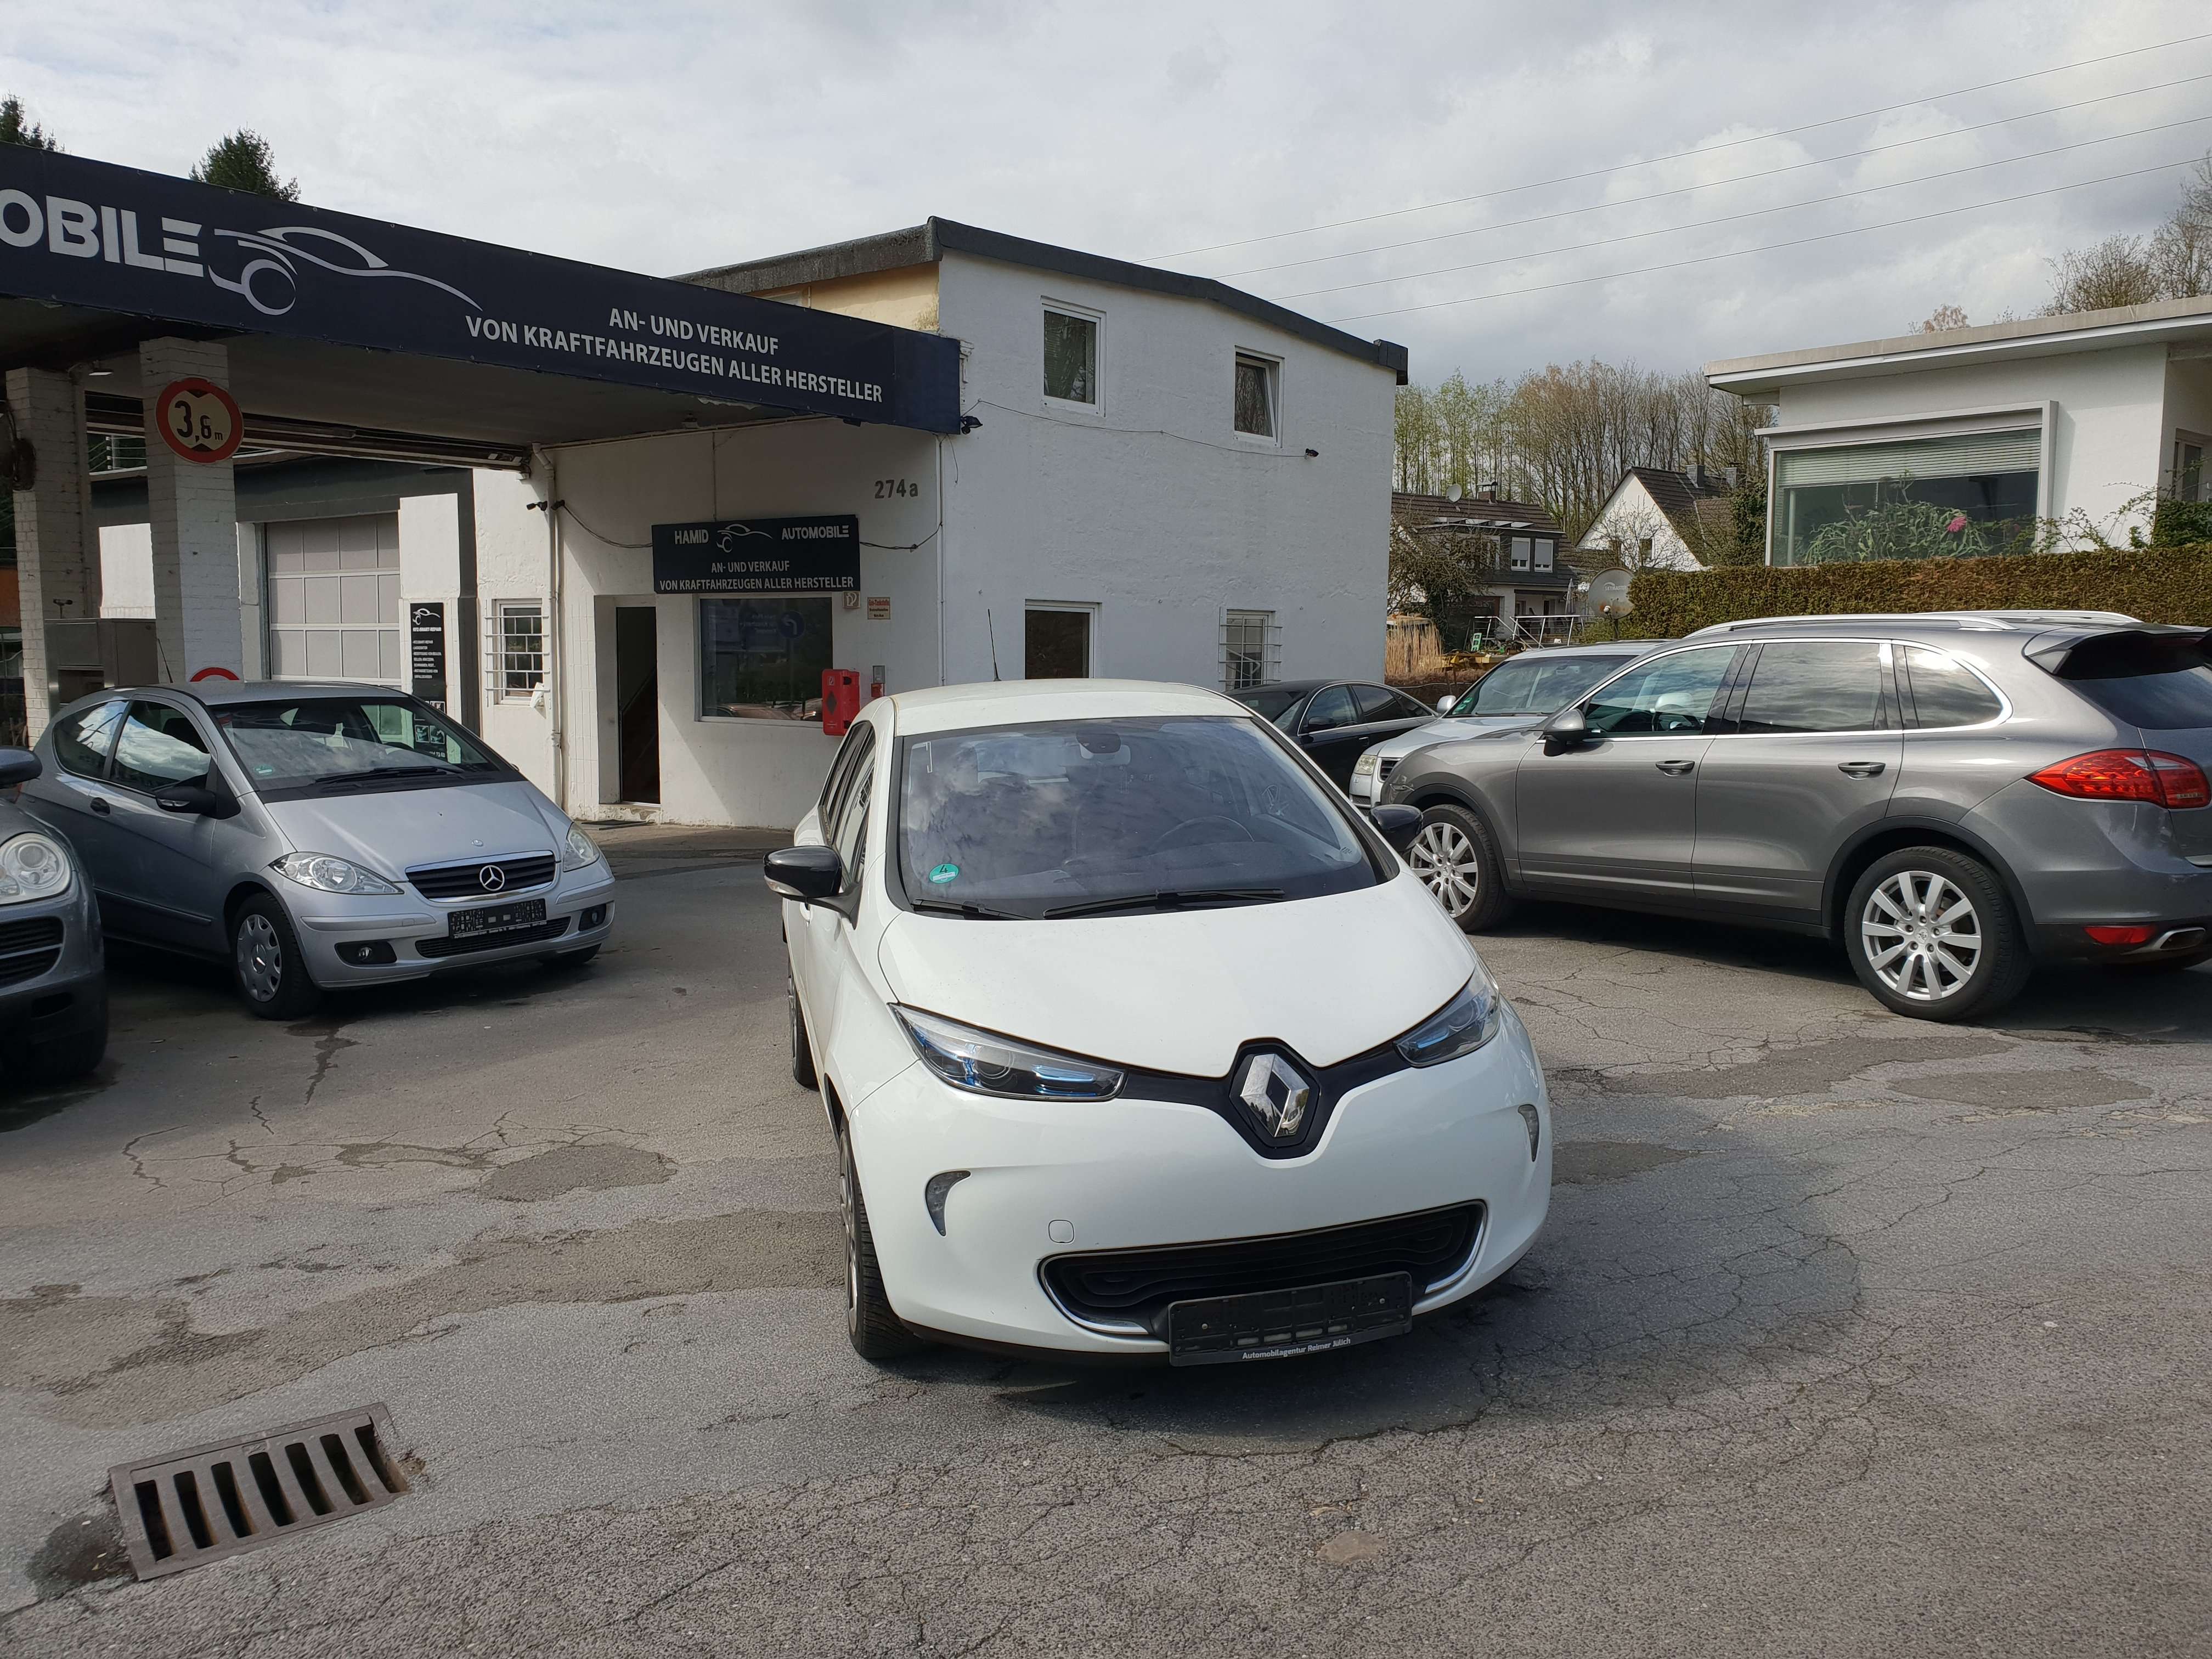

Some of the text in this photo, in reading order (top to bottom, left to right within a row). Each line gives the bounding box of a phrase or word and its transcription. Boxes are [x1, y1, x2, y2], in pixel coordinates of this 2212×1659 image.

[609, 308, 779, 356] AN- UND VERKAUF
[465, 315, 883, 403] VON KRAFTFAHRZEUGEN ALLER HERSTELLER
[874, 479, 918, 499] 274a
[674, 525, 850, 545] HAMID AUTOMOBILE
[711, 560, 790, 573] AN- UND VERKAUF
[659, 577, 854, 590] VON KRAFTFAHRZEUGEN ALLER HERSTELLER
[939, 865, 949, 873] 4
[1242, 1337, 1351, 1359] Automobilagentur Reimer Jülich
